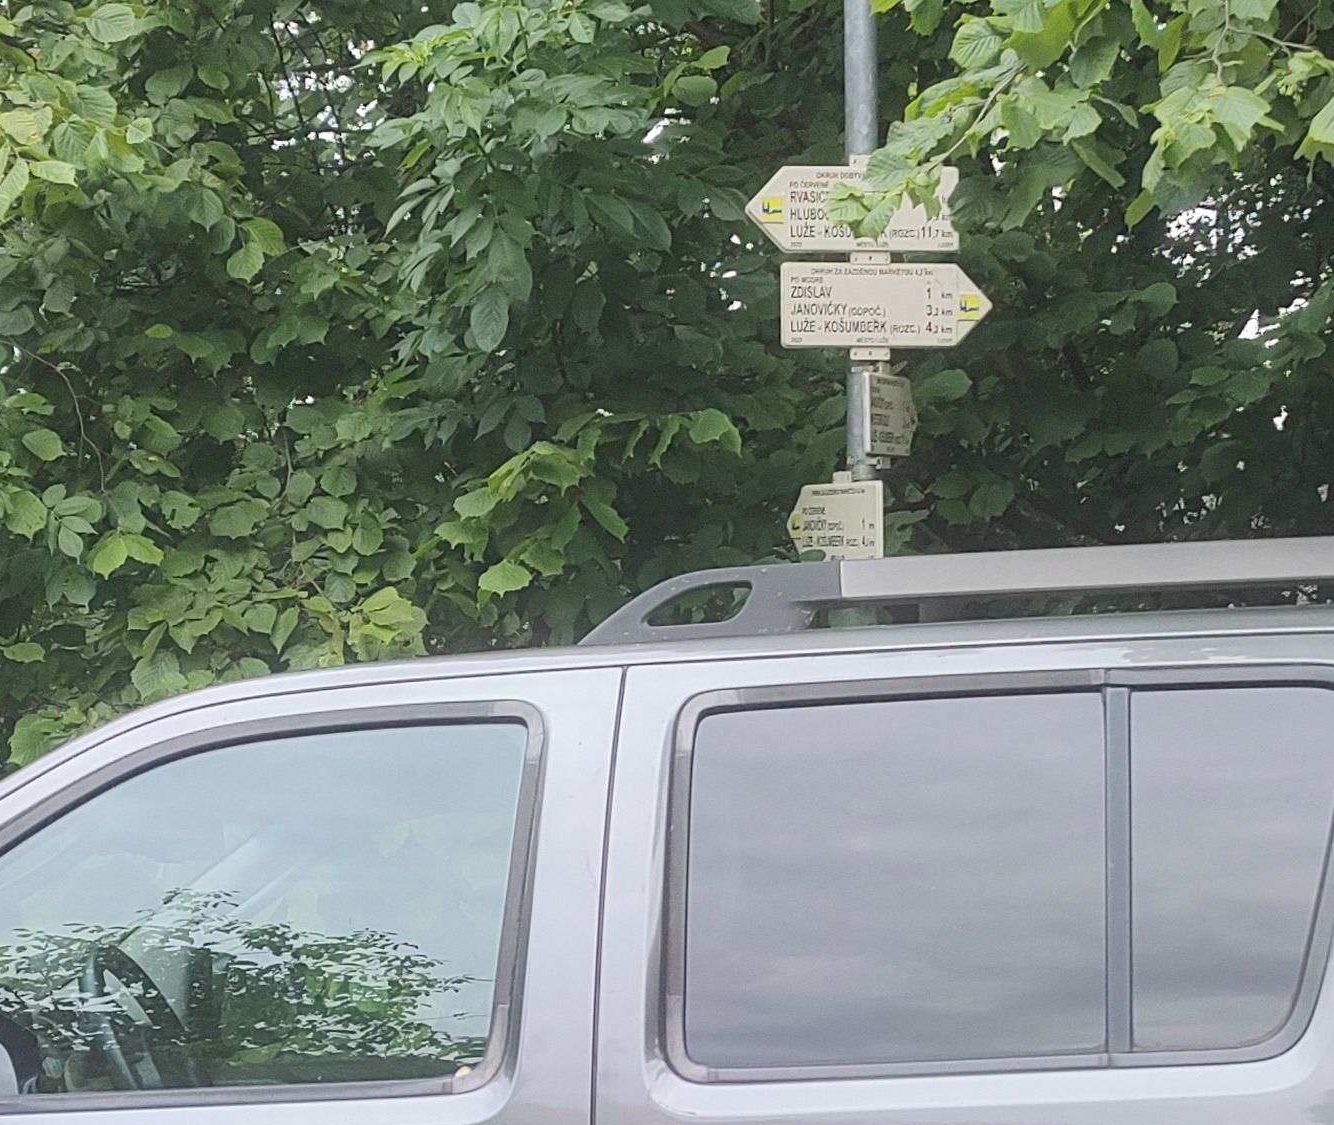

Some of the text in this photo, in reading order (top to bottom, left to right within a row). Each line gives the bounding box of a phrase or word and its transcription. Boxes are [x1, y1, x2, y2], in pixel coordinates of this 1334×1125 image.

[790, 222, 816, 238] LUŽE
[921, 226, 939, 239] 11,7
[790, 285, 953, 299] ZDISLAV 1 km
[790, 300, 848, 316] JANOVIČKY
[790, 317, 816, 333] LUŽE
[824, 317, 887, 333] KOŠUMBERK
